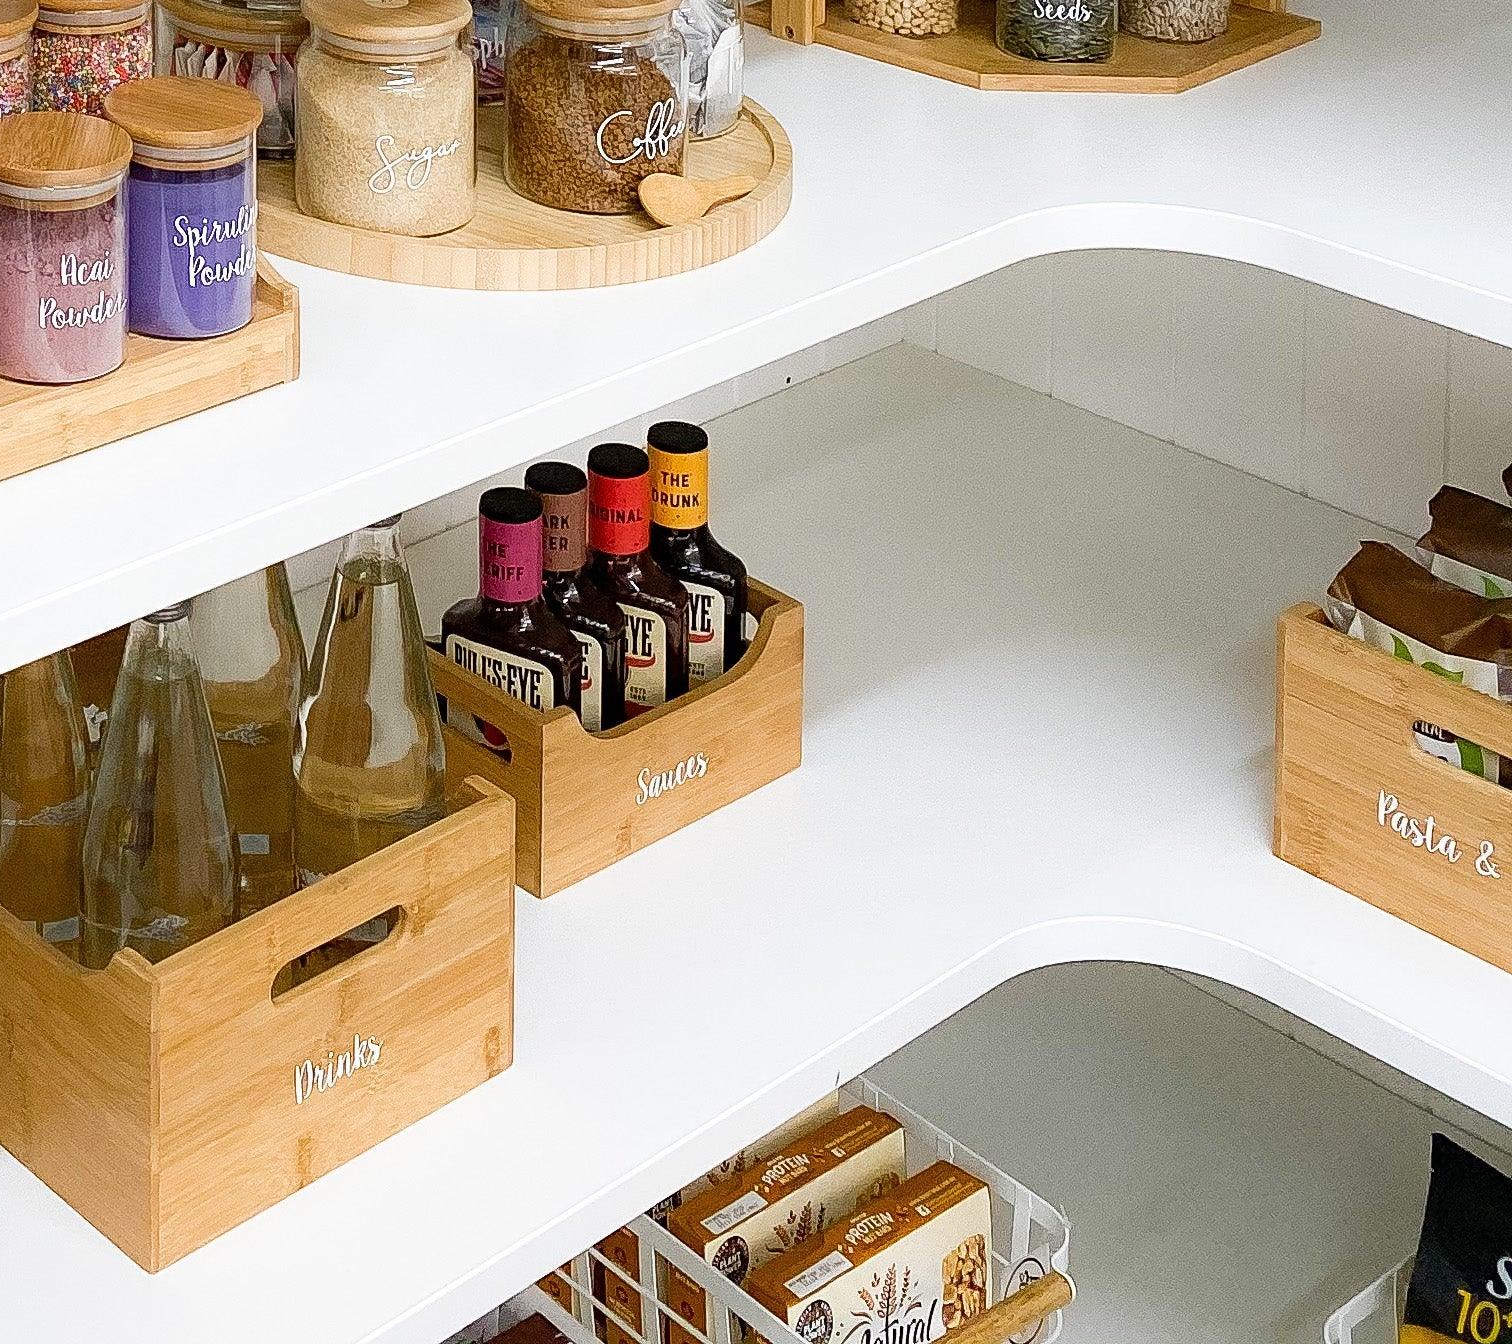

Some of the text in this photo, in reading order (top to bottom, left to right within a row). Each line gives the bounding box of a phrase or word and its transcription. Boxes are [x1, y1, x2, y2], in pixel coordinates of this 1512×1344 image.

[367, 133, 463, 196] Sugar
[60, 250, 116, 287] Acai
[37, 288, 129, 331] Powder
[651, 486, 701, 509] DRUNK
[660, 470, 690, 488] THE
[635, 750, 711, 806] Sauces
[1376, 788, 1502, 879] Pasta &
[293, 1032, 384, 1106] Drinks
[761, 1153, 811, 1187] PROTEIN
[844, 1210, 895, 1248] PROTEIN
